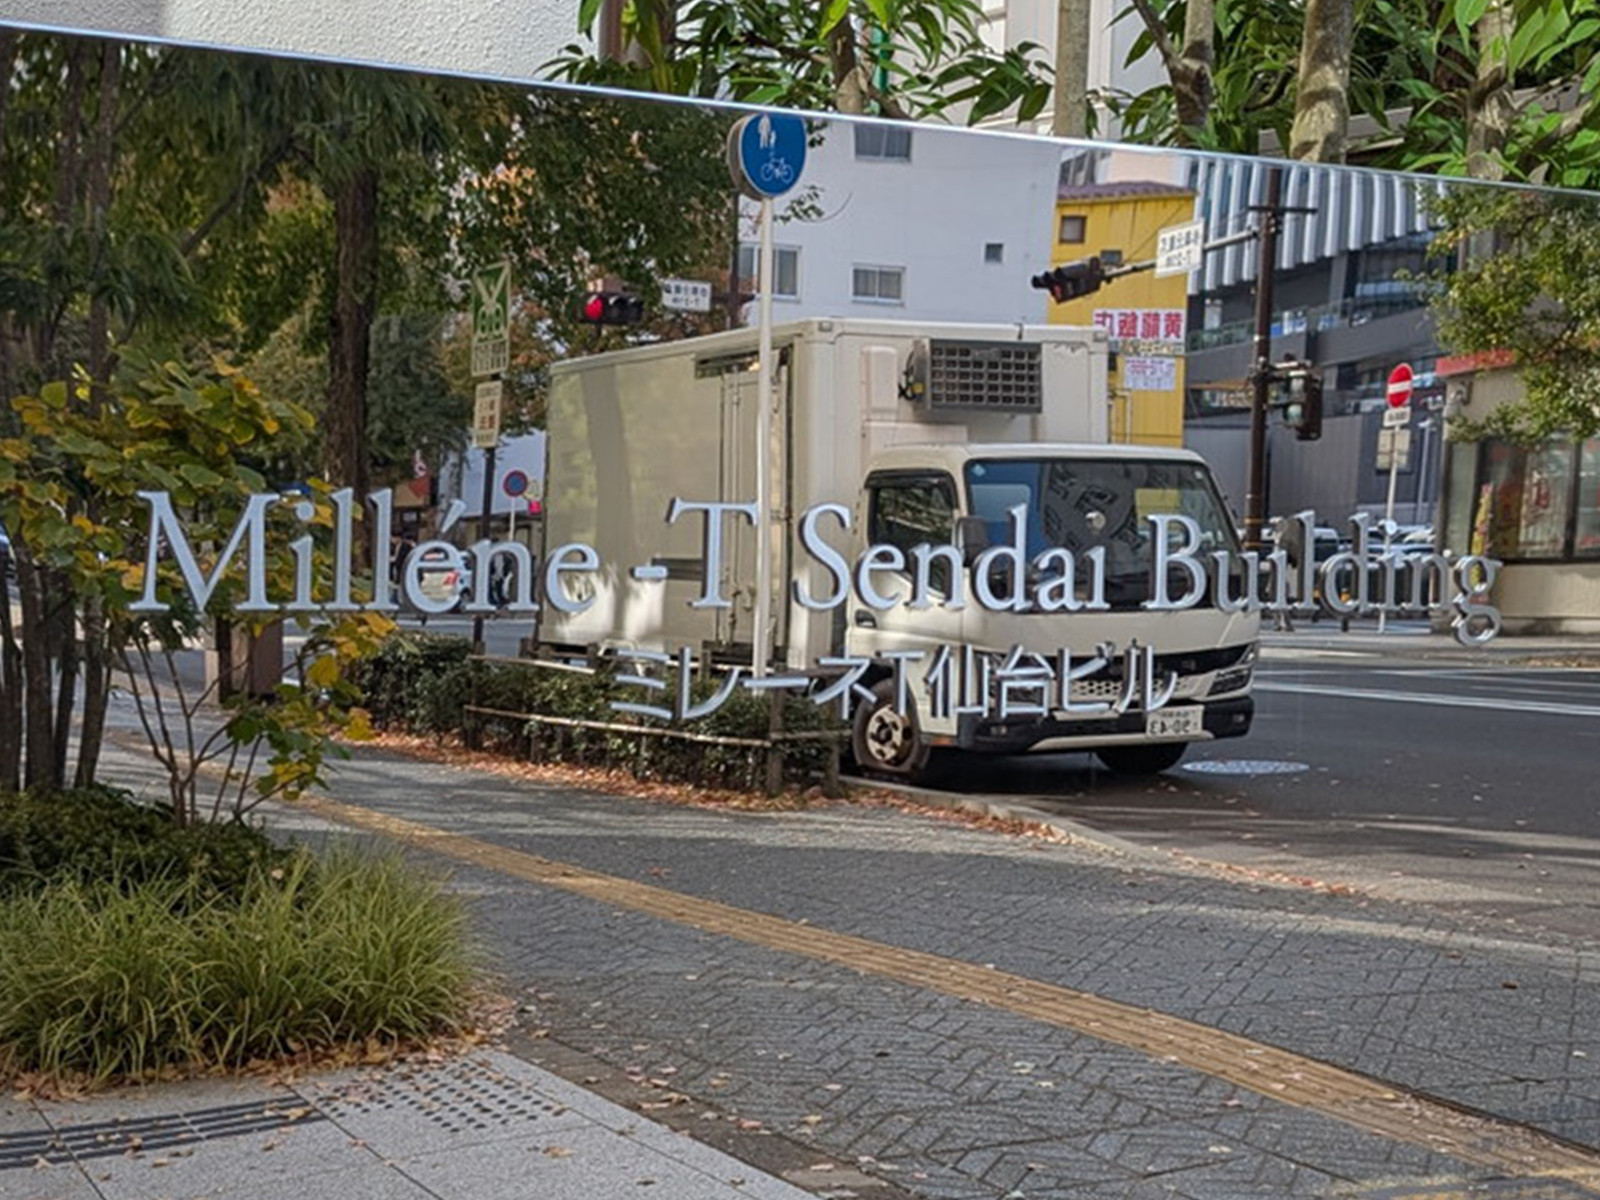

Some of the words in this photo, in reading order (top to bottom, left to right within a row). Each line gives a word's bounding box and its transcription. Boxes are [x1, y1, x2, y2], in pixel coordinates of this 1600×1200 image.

[128, 487, 600, 613] Milléne
[792, 502, 1111, 614] Sendai
[1140, 509, 1503, 646] Building
